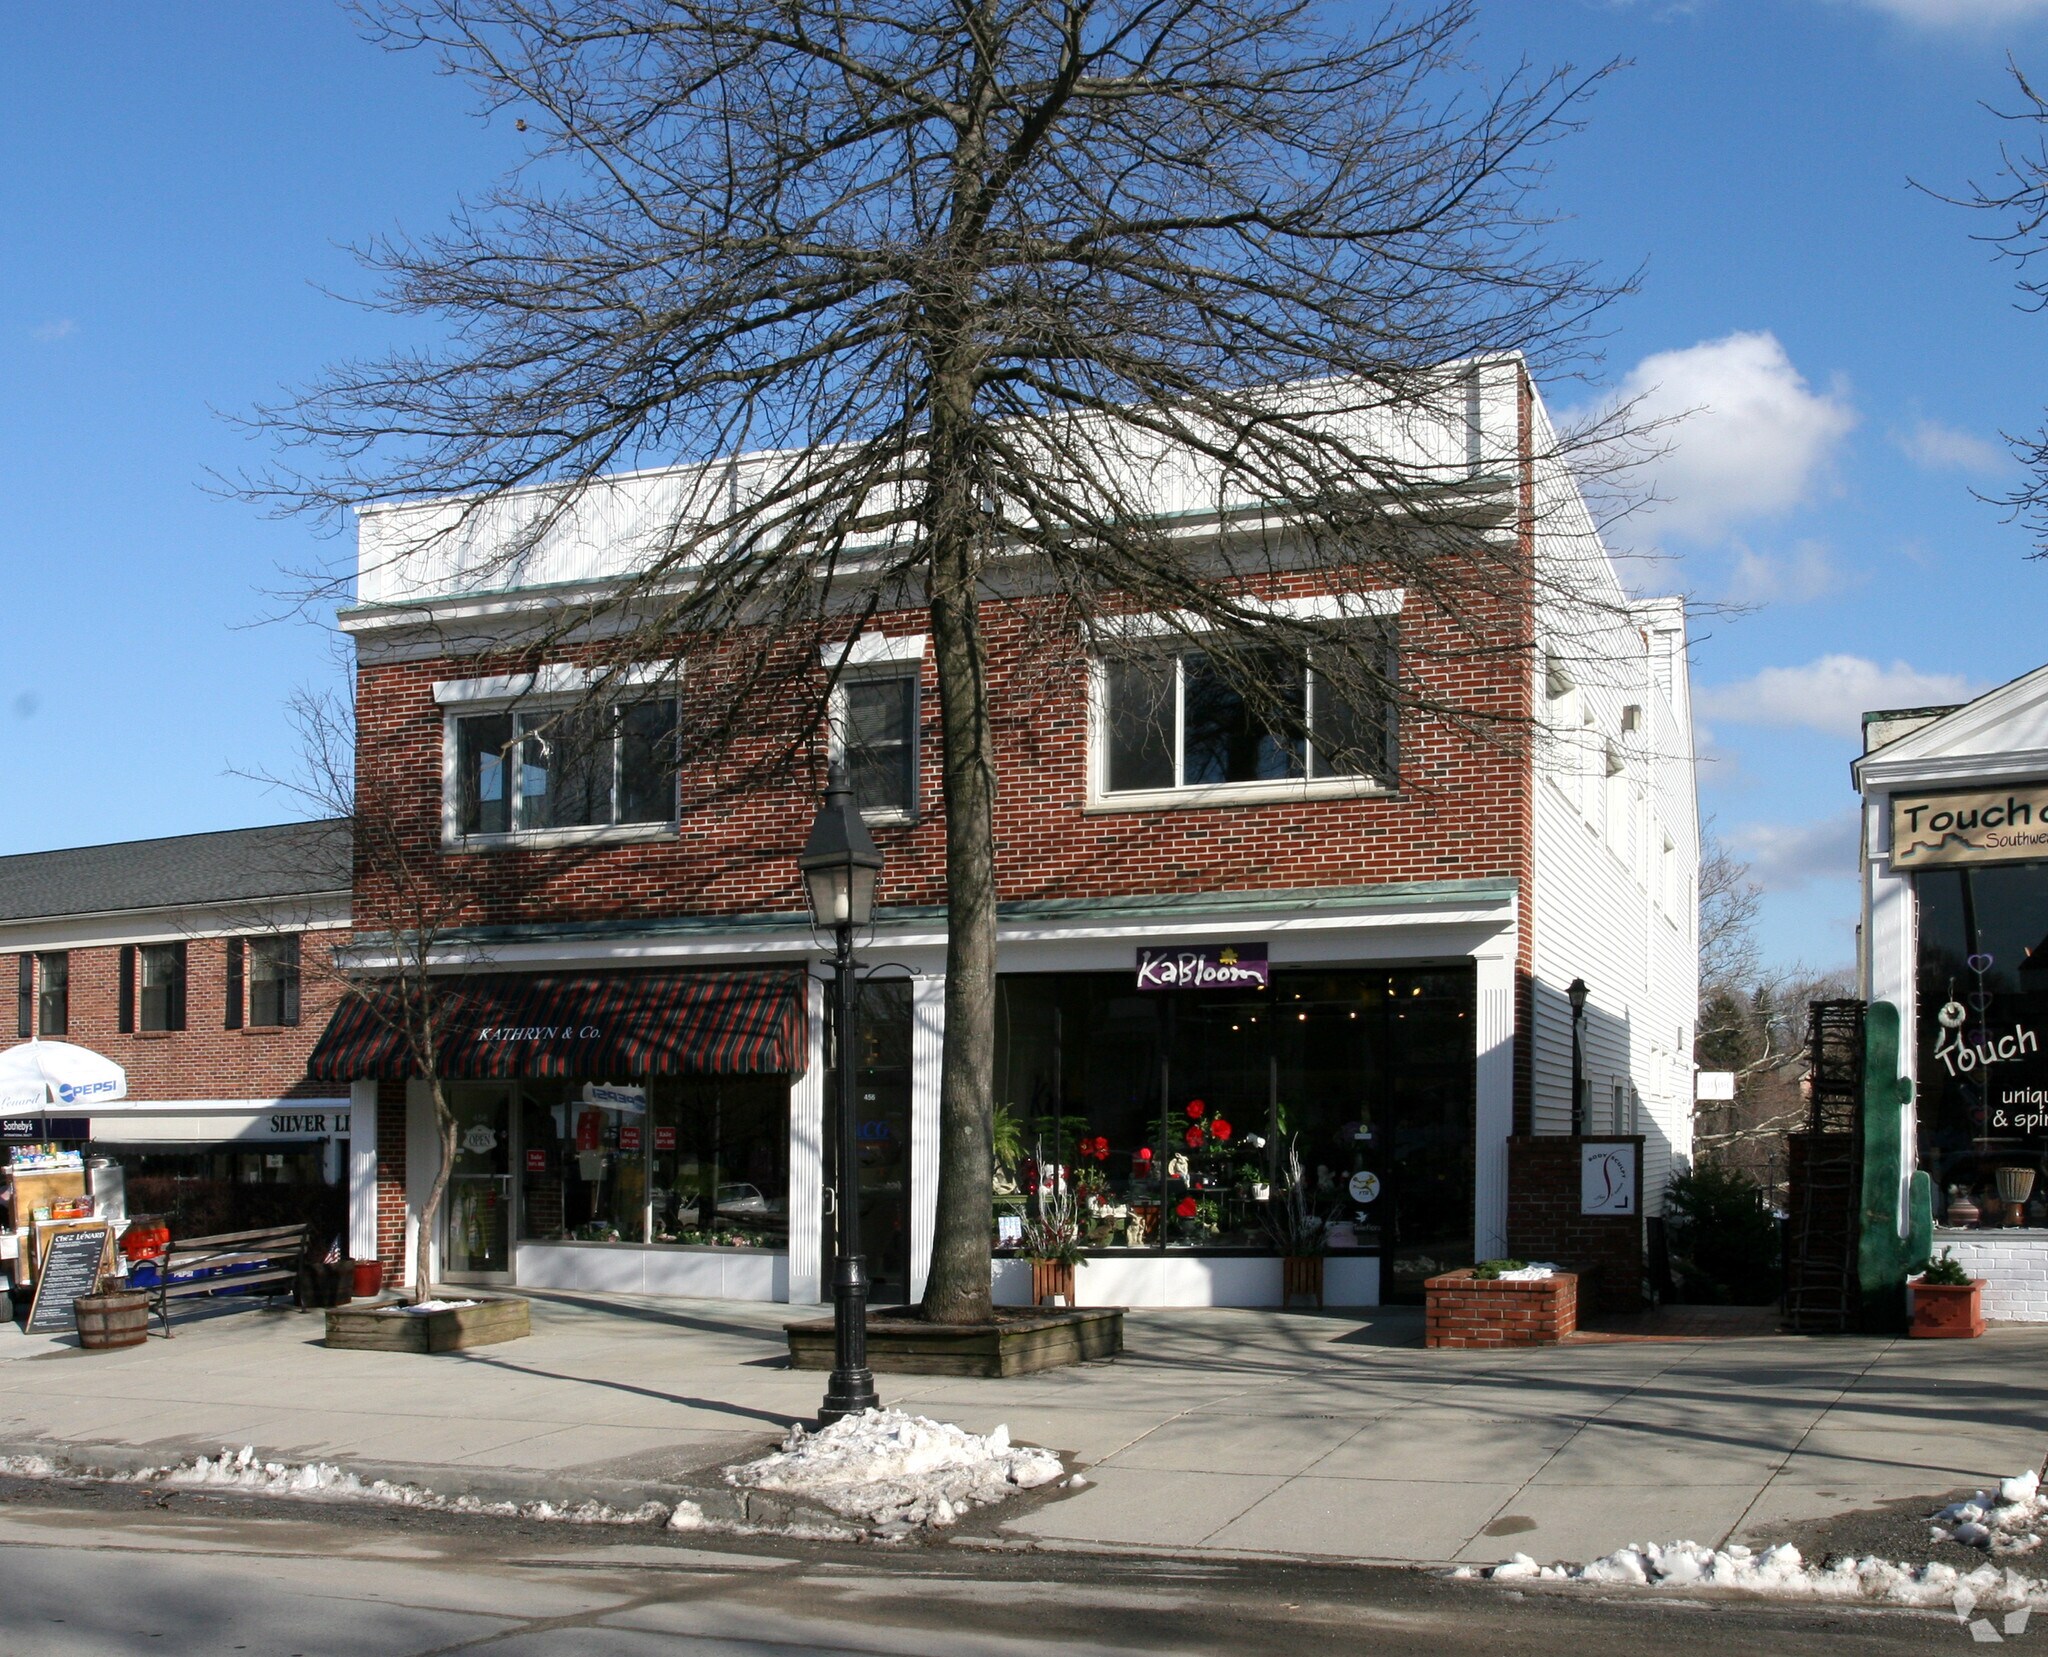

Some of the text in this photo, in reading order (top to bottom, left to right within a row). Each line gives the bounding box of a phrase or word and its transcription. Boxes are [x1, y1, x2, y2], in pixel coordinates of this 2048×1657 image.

[1903, 797, 2031, 833] Touch
[1986, 831, 2048, 849] Southwe
[1137, 951, 1264, 988] KaBloom
[477, 1026, 559, 1041] KATHRYN
[561, 1026, 573, 1039] &
[1935, 1024, 2038, 1077] Touch
[73, 1080, 116, 1097] PEPSI
[3, 1120, 33, 1133] Sotheby's
[270, 1114, 326, 1133] SILVER
[1993, 1109, 2008, 1128] &
[469, 1134, 491, 1146] OPEN
[1588, 1153, 1607, 1162] BODY
